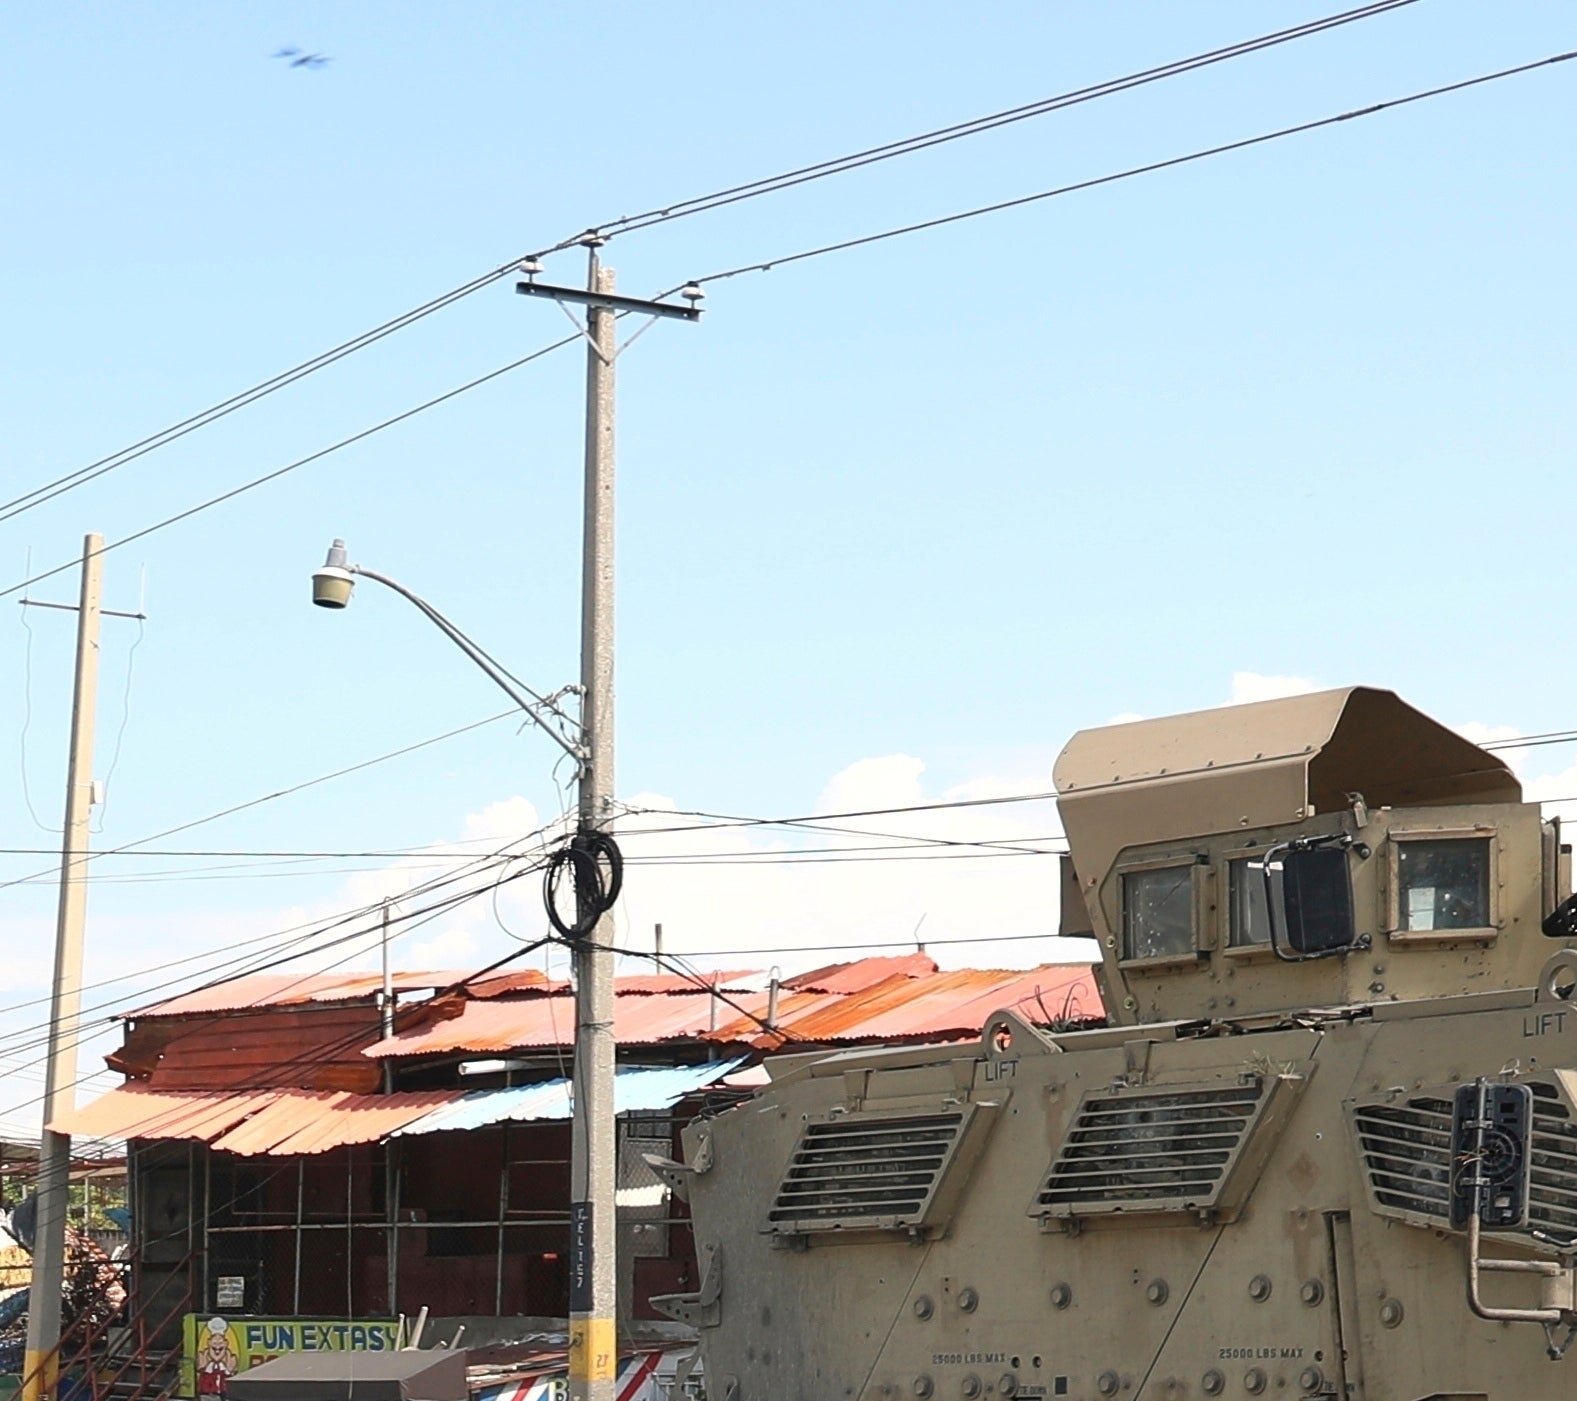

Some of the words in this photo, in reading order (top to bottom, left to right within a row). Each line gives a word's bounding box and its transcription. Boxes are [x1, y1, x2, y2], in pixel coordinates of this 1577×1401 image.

[1523, 1012, 1566, 1037] LIFT
[985, 1060, 1018, 1081] LIFT
[248, 1325, 294, 1350] FUN
[301, 1325, 397, 1351] EXTASY
[1219, 1348, 1253, 1359] 25000
[1256, 1348, 1276, 1359] LBS
[1280, 1348, 1304, 1358] MAX
